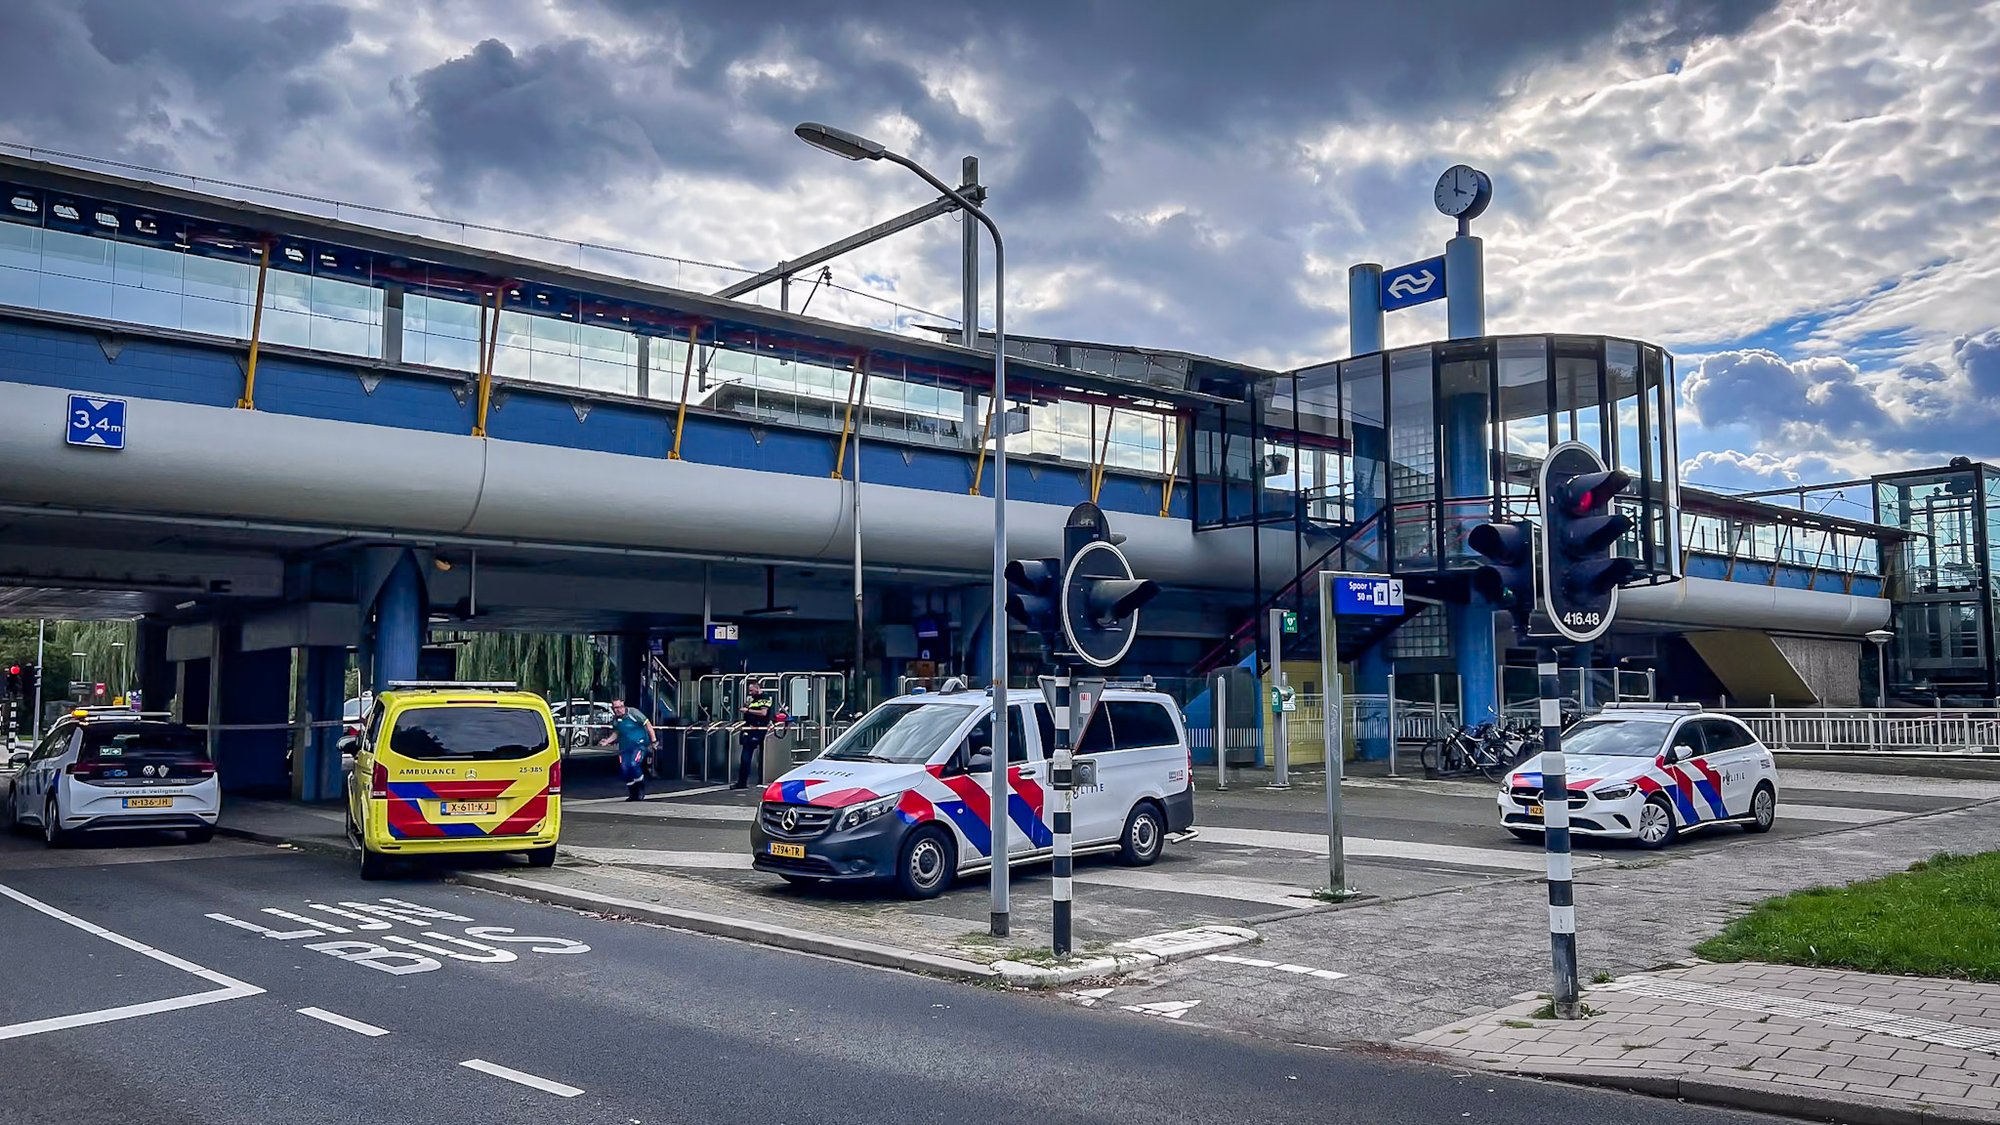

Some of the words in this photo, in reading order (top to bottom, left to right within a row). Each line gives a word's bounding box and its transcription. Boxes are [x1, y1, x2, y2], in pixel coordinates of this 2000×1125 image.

[1349, 581, 1367, 591] Spoor
[1357, 592, 1365, 601] 50
[1563, 611, 1600, 625] 416.48
[451, 802, 489, 812] X-611-KJ
[302, 926, 592, 976] BUS
